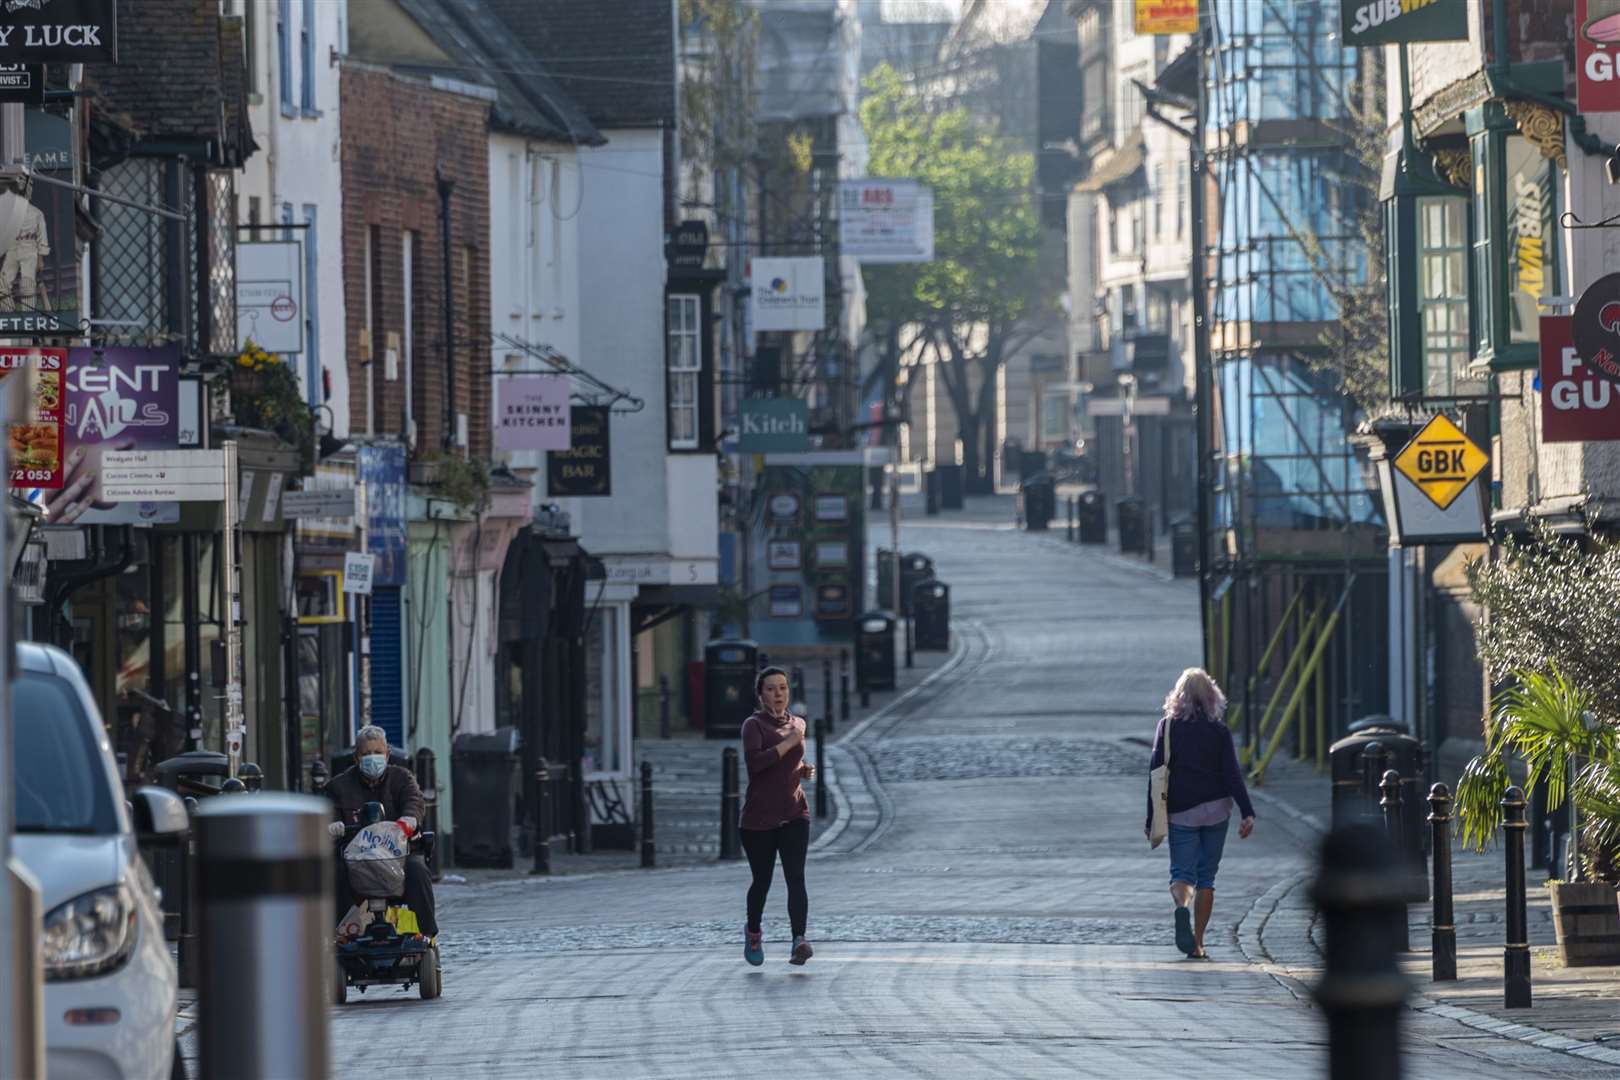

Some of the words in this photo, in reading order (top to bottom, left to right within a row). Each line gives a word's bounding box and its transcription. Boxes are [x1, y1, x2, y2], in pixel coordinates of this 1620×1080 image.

[24, 25, 101, 46] LUCK
[1515, 172, 1544, 310] SUBWAY
[1551, 380, 1620, 410] GU
[507, 405, 561, 415] SKINNY
[502, 417, 566, 427] KITCHEN
[743, 413, 804, 434] Kitch
[562, 465, 595, 478] BAR
[1417, 450, 1466, 474] GBK
